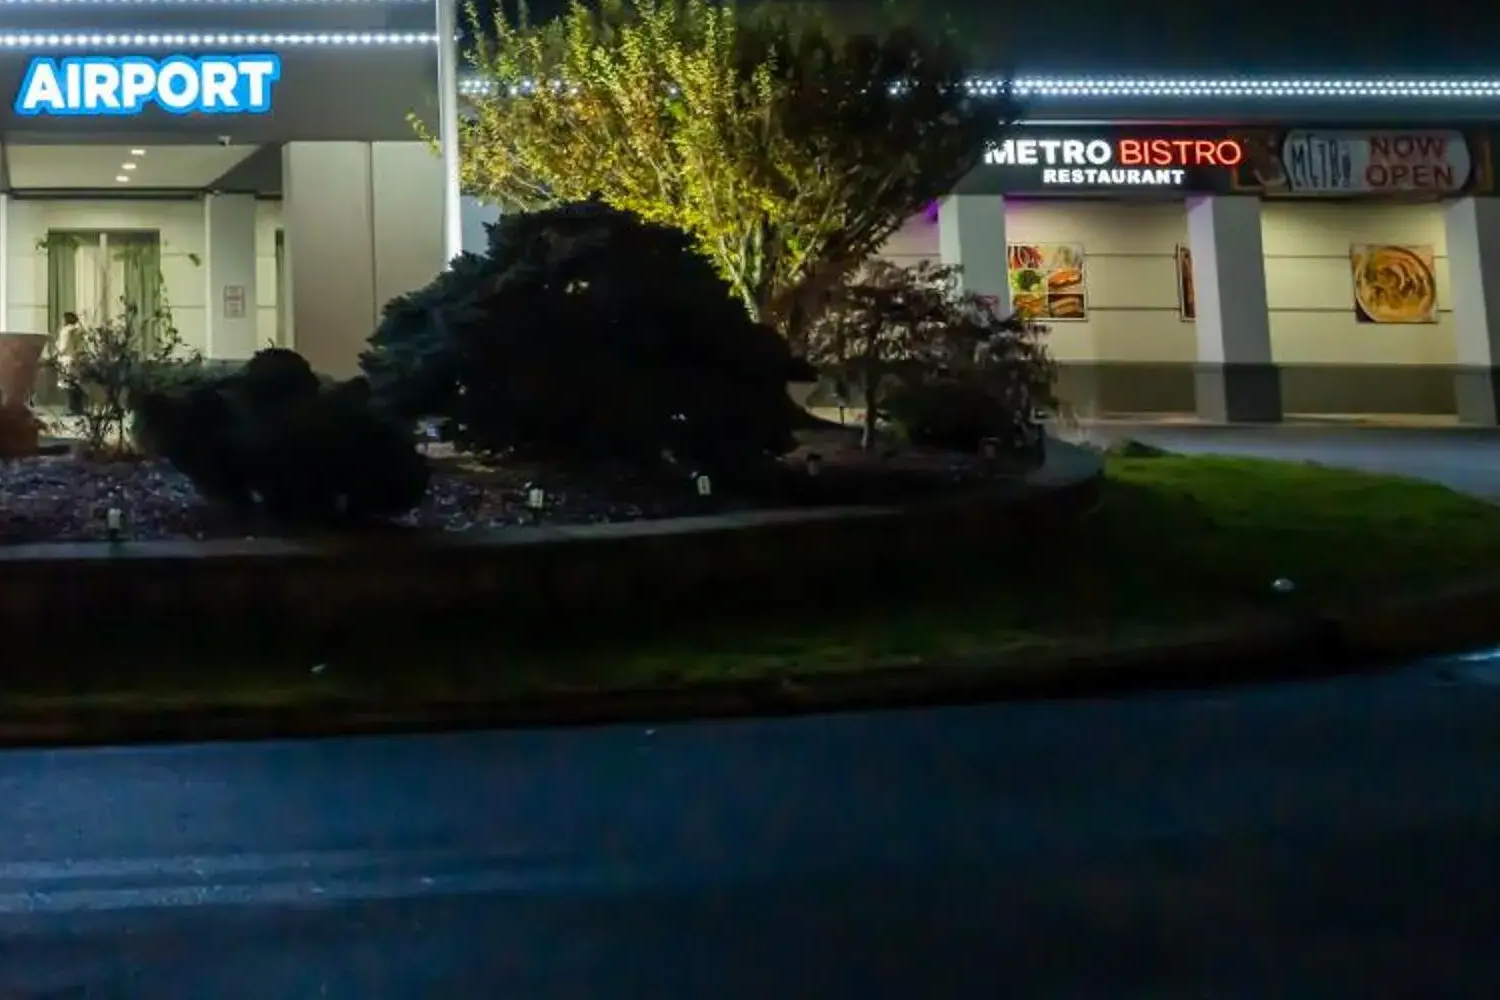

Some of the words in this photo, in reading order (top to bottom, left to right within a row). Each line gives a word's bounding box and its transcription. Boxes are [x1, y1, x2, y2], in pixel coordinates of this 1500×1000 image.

[23, 61, 273, 108] AIRPORT
[984, 139, 1111, 164] METRO
[1119, 139, 1242, 165] BISTRO
[1369, 135, 1446, 158] NOW
[1043, 168, 1185, 184] RESTAURANT
[1366, 164, 1453, 187] OPEN
